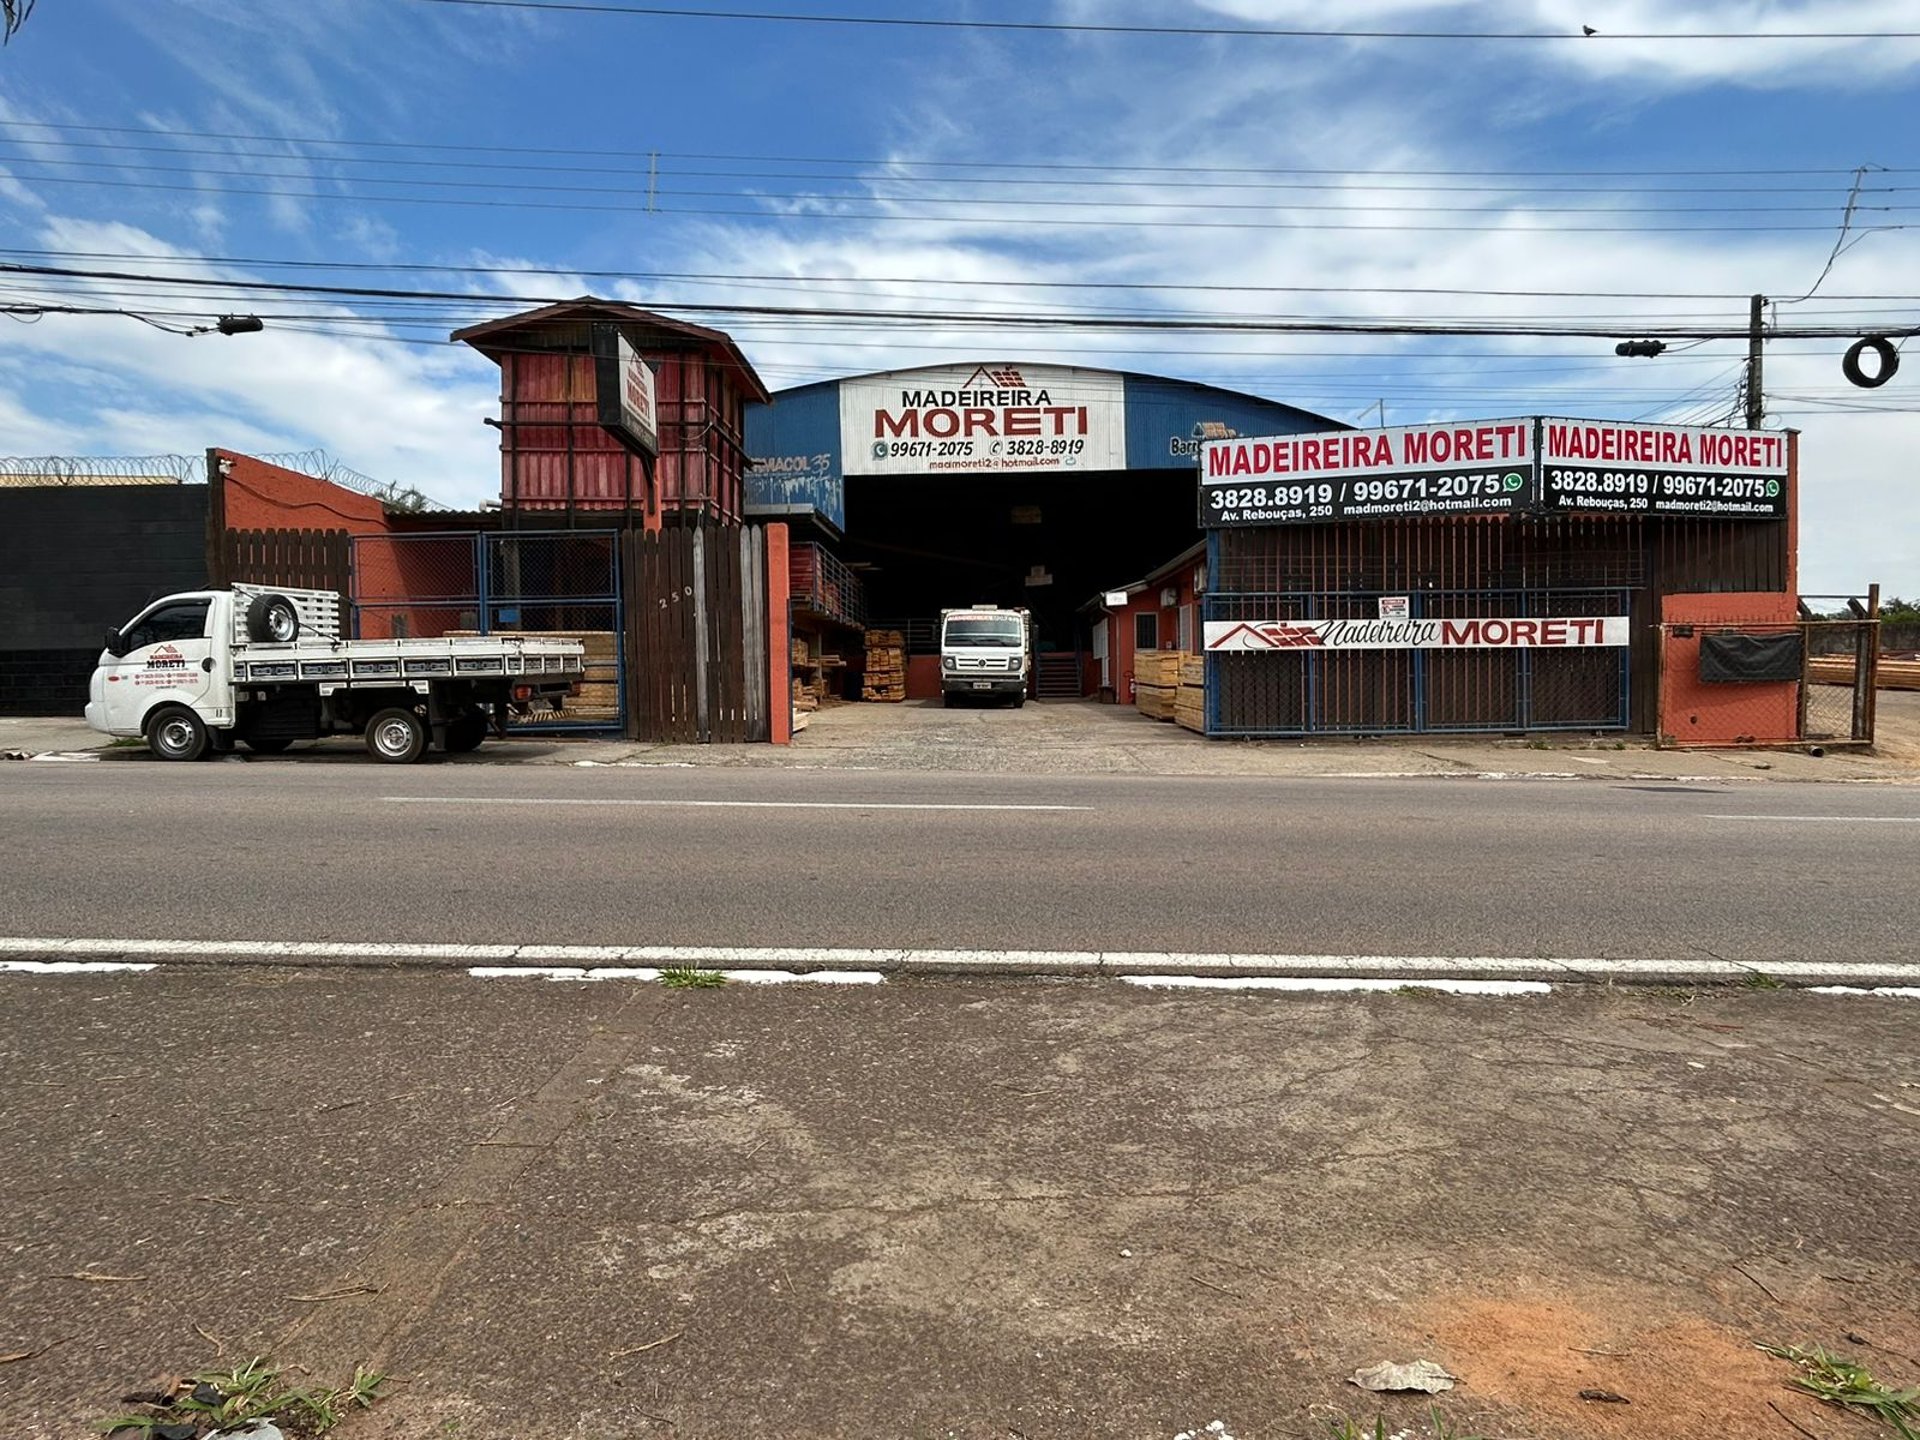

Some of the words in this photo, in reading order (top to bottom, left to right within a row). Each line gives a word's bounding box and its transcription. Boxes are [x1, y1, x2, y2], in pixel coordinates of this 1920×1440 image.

[901, 390, 1052, 407] MADEIREIRA
[874, 406, 1088, 438] MORETI
[890, 441, 973, 457] 99671-2075
[1007, 439, 1084, 455] 3828-8919
[1209, 436, 1394, 476] MADEIREIRA
[1404, 425, 1525, 464] MORETI
[1549, 425, 1692, 464] MADEIREIRA
[1700, 434, 1781, 467] MORETI
[1210, 484, 1333, 509] 3828.8919
[1353, 474, 1500, 501] 99671-2075
[1551, 470, 1648, 494] 3828.8919
[1663, 475, 1765, 497] 99671-2075
[1221, 510, 1239, 521] Av.
[1242, 508, 1306, 520] Rebouças,
[1309, 505, 1333, 516] 250
[1343, 497, 1512, 515] madmoreti2@hotmail.com
[1558, 495, 1574, 506] Av.
[1577, 496, 1628, 510] Rebouças,
[1629, 498, 1649, 509] 250
[1655, 500, 1774, 512] madmoreti2@hotmail.com
[658, 585, 693, 609] 250
[1442, 619, 1604, 646] MORETI
[146, 659, 186, 669] MORETI
